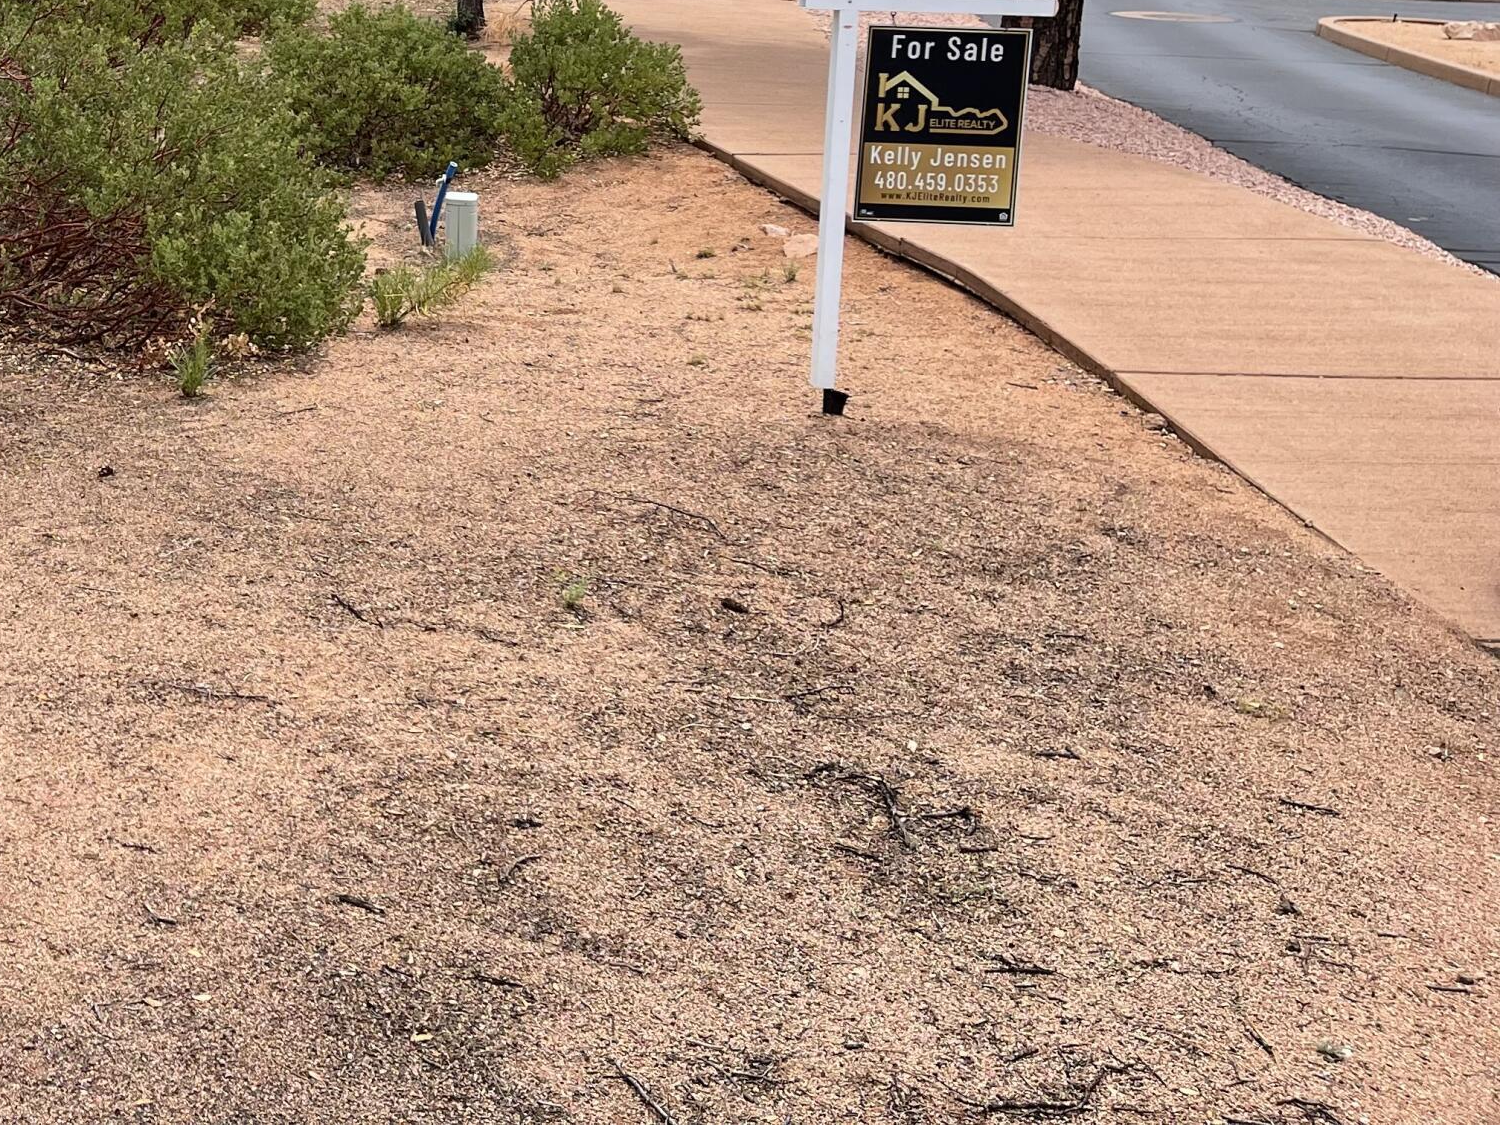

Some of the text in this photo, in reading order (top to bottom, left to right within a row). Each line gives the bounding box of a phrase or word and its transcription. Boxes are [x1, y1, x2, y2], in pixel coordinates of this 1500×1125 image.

[891, 34, 1004, 62] For Sale
[929, 118, 996, 130] ELITE REALTY
[870, 145, 1006, 170] Kelly Jensen
[874, 171, 999, 193] 480.459.0353
[880, 191, 990, 204] www.KJEliteRealty.com
